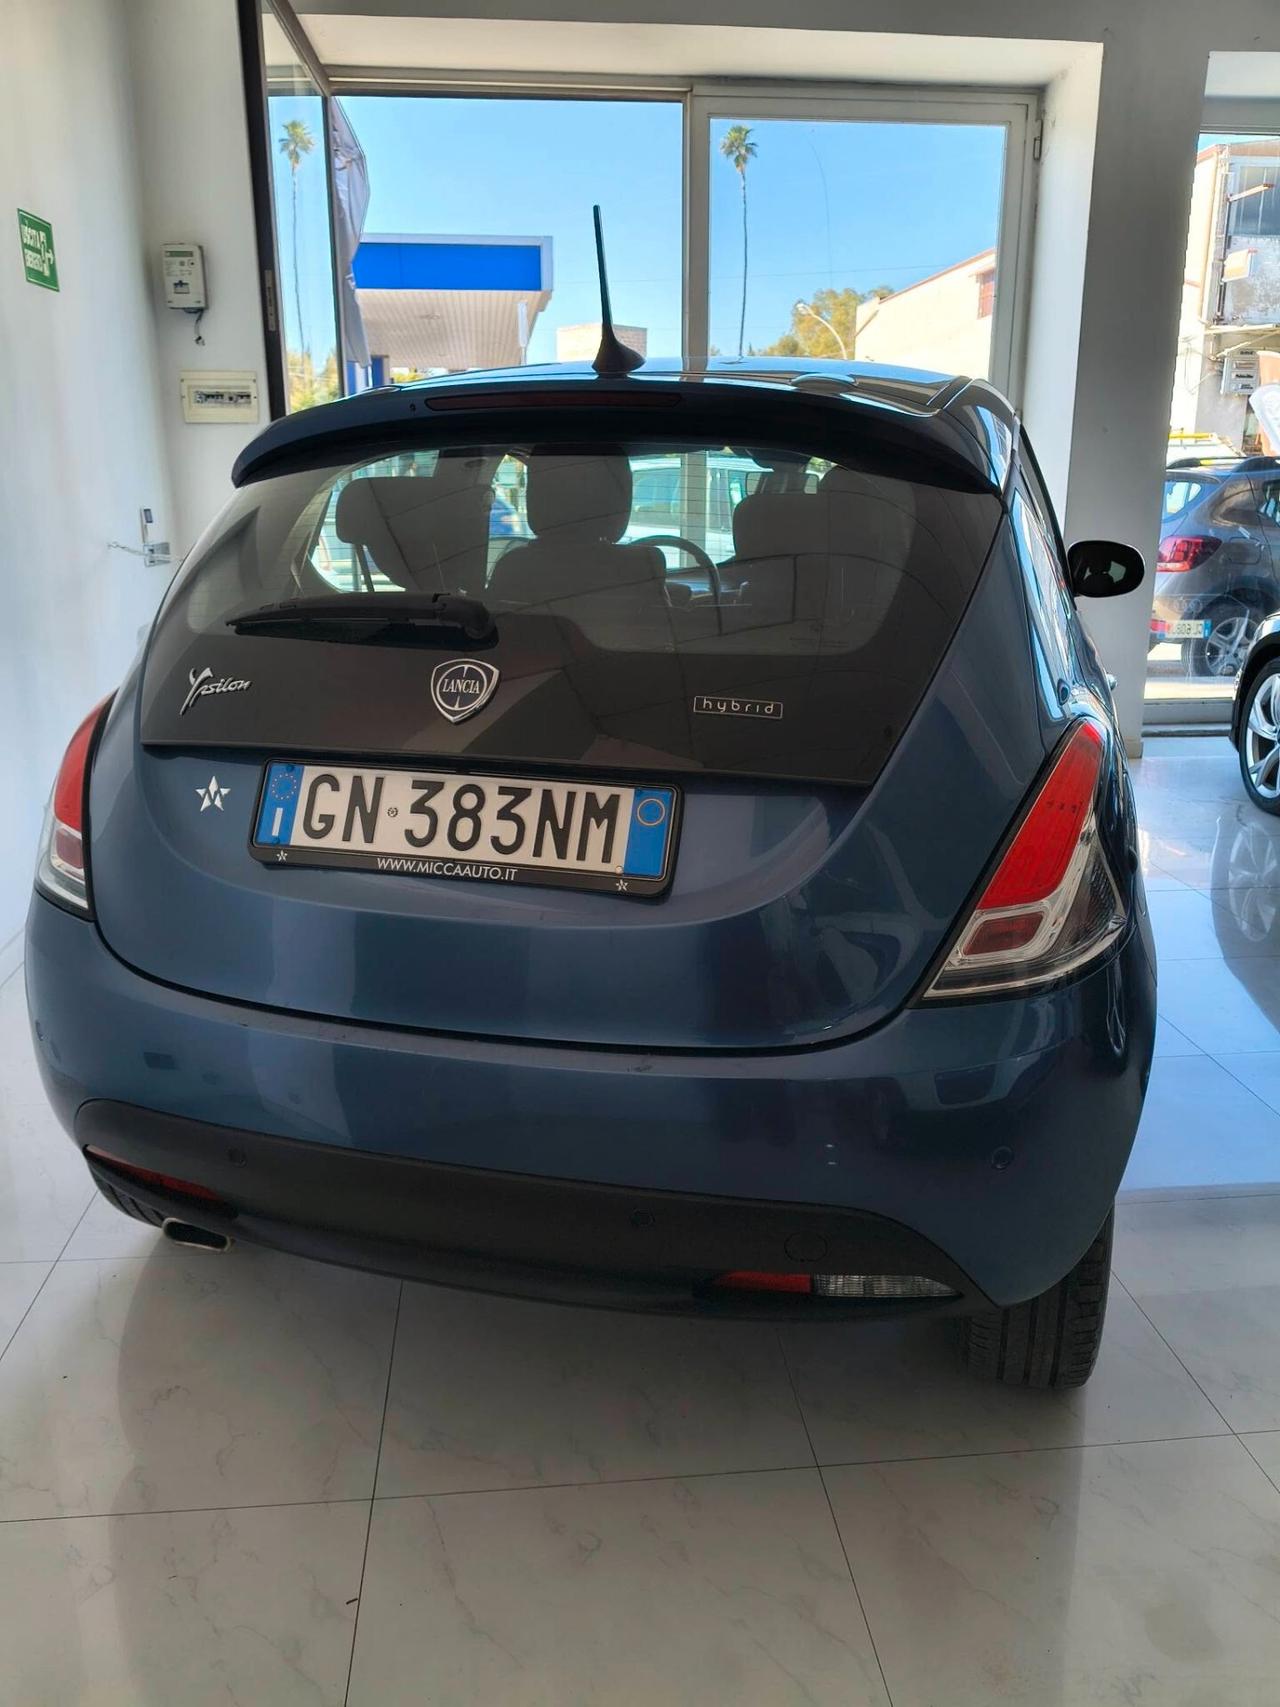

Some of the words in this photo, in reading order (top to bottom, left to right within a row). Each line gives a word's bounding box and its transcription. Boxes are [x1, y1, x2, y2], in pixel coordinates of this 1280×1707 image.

[180, 667, 252, 715] Ypsilon
[442, 678, 480, 694] LANCIA
[702, 698, 774, 714] hybrid
[376, 857, 518, 881] WWW.MICCAAUTO.IT
